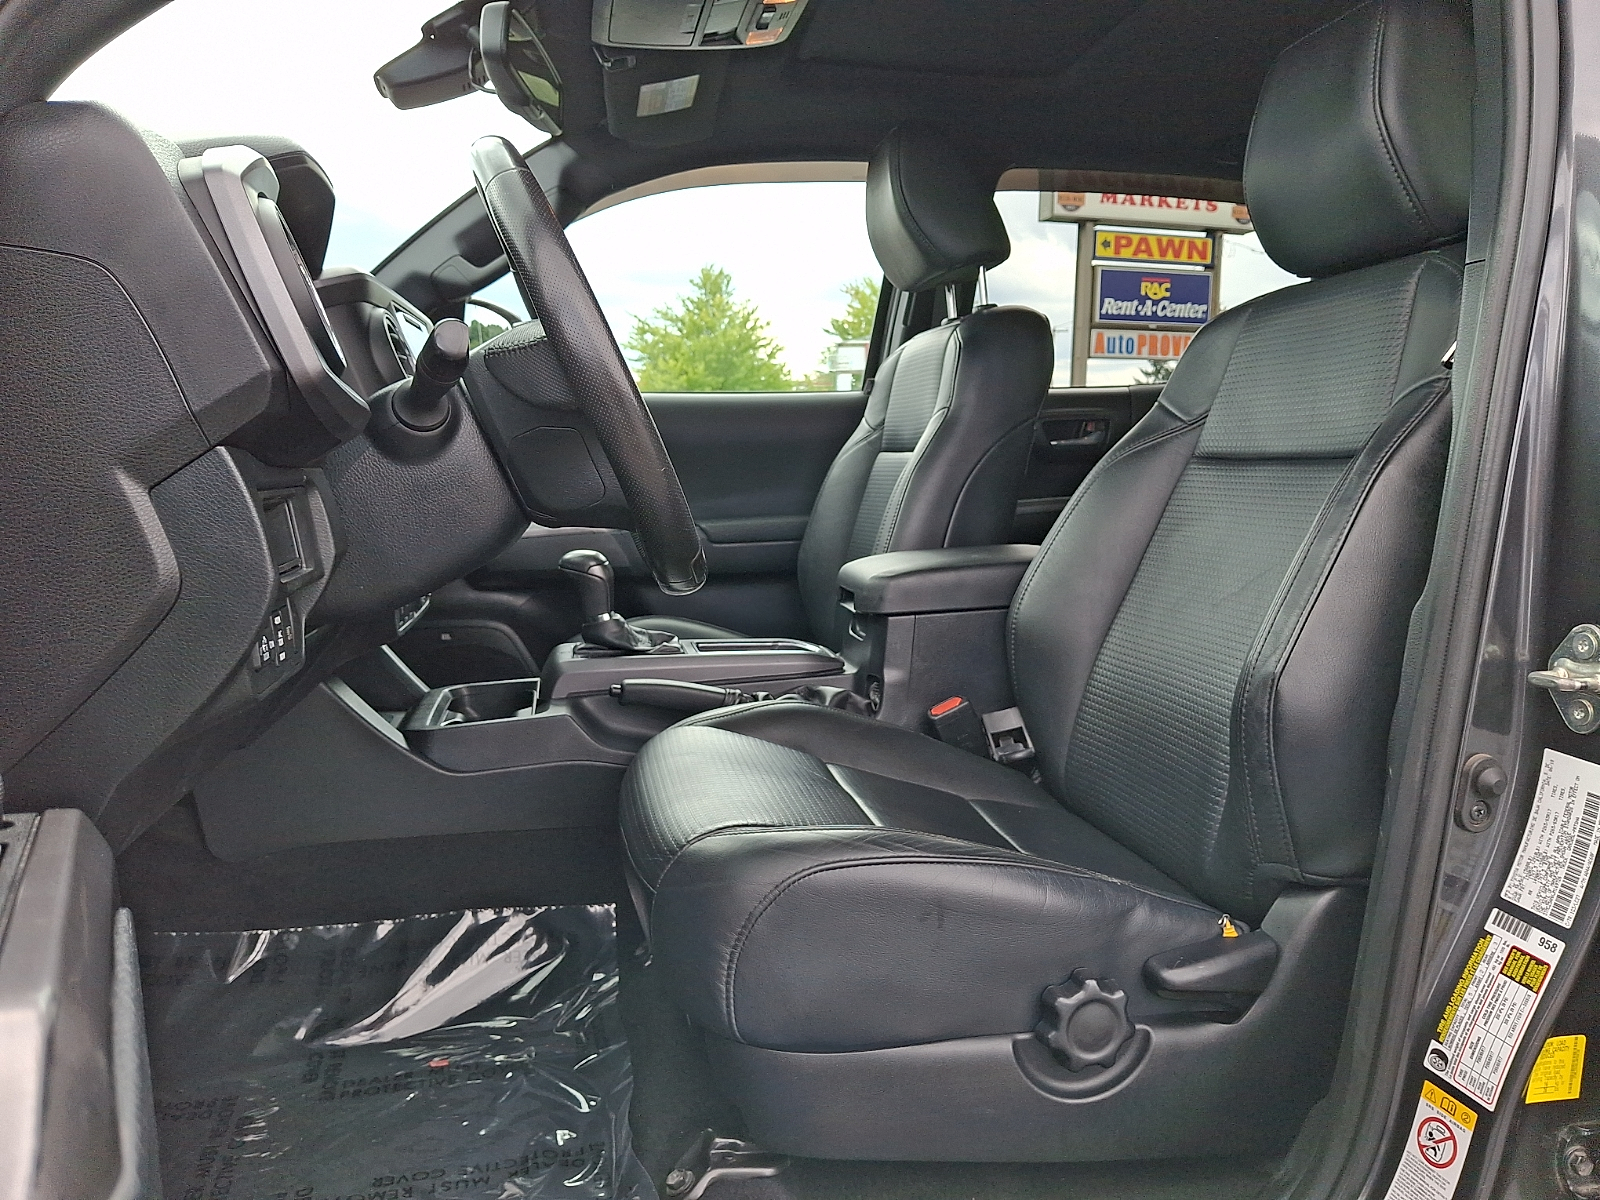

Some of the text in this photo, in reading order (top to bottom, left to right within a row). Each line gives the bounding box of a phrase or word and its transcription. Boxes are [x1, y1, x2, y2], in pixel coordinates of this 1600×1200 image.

[1101, 193, 1218, 212] MARKETS
[1113, 235, 1208, 260] PAWN
[1538, 937, 1558, 953] 958
[1449, 978, 1464, 1005] LOADING
[1462, 937, 1484, 979] INFORMATION
[372, 1167, 447, 1188] COVER
